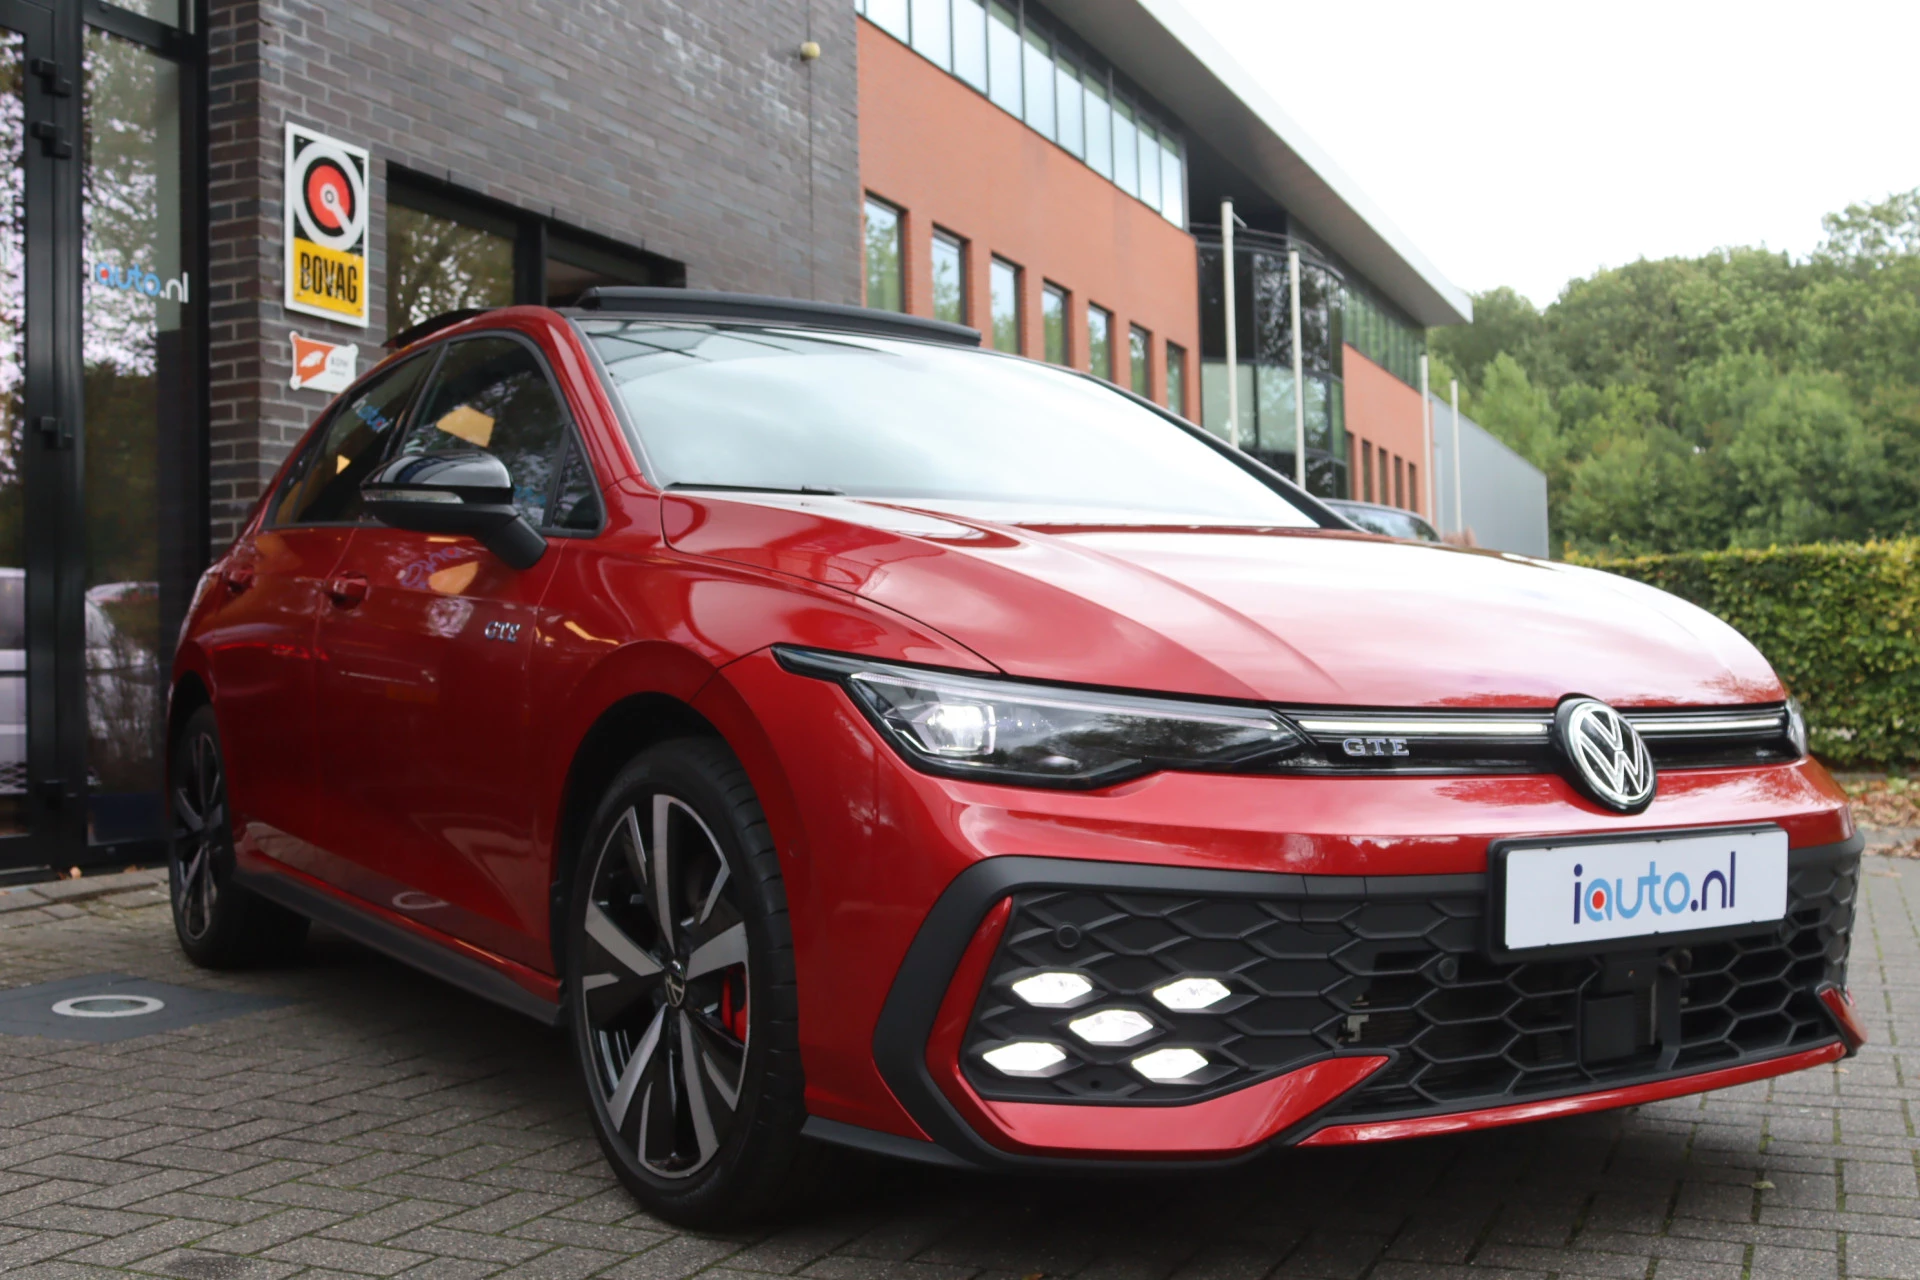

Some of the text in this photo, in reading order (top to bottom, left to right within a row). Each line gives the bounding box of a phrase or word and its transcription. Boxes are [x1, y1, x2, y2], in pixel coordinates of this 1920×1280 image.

[300, 252, 358, 304] BOVAG
[484, 621, 521, 642] GTE
[1342, 738, 1410, 756] GTE
[1573, 851, 1736, 924] iauto.nl
